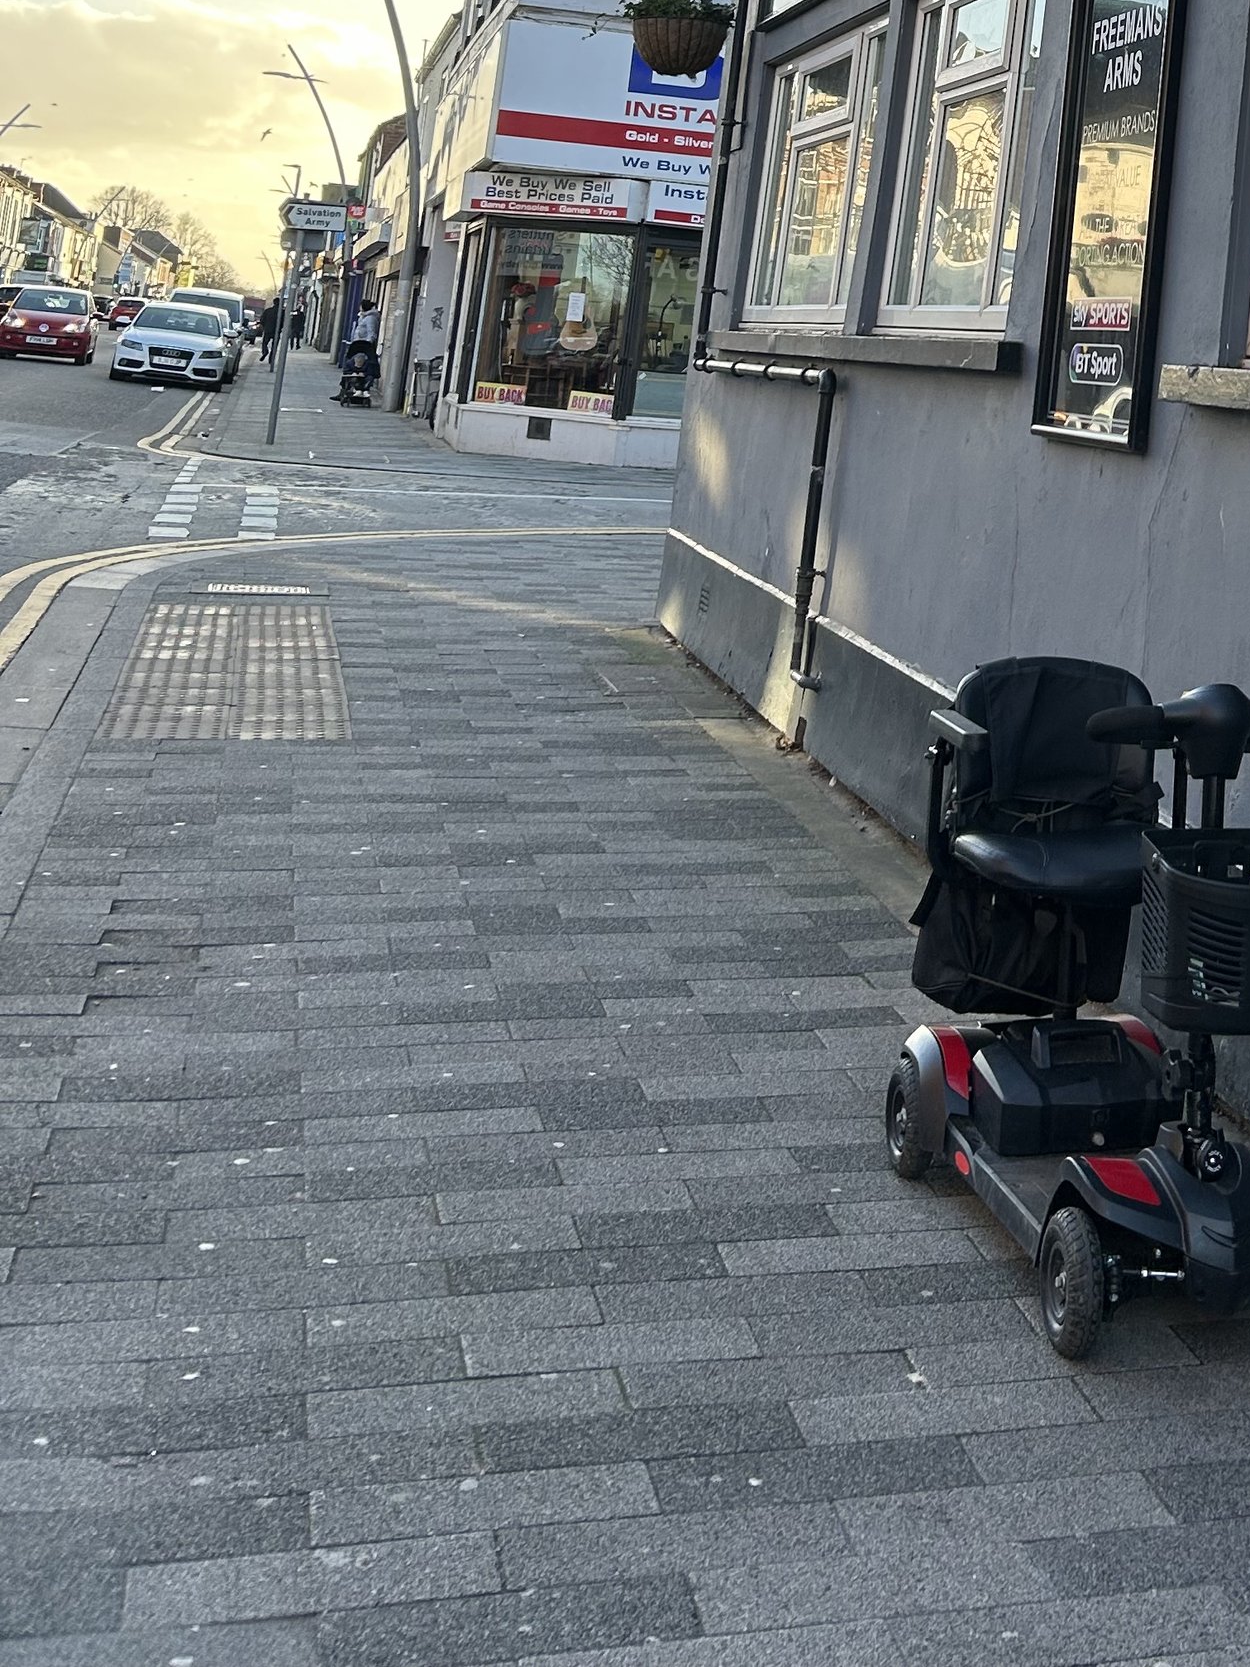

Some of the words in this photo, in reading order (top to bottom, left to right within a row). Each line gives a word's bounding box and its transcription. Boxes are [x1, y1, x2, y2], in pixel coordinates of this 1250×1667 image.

[1092, 1, 1166, 55] FREEMANS
[1103, 50, 1142, 93] ARMS
[625, 130, 659, 143] Gold
[1083, 119, 1121, 144] PREMIUM
[1121, 110, 1156, 137] BRANDS
[622, 156, 650, 169] We
[657, 160, 692, 175] Buy
[491, 174, 514, 187] We
[519, 177, 548, 191] Buy
[554, 178, 577, 191] We
[582, 180, 611, 193] Sell
[1115, 165, 1141, 188] VALUE
[485, 186, 521, 199] Best
[526, 189, 575, 202] Prices
[580, 192, 614, 205] Paid
[664, 184, 708, 201] Inst
[296, 207, 341, 218] Salvation
[480, 201, 506, 210] Game
[508, 202, 549, 213] Consoles
[559, 205, 591, 214] Games
[305, 218, 331, 227] Army
[1111, 242, 1144, 264] ACTION
[1073, 301, 1088, 327] sky
[1089, 302, 1129, 324] SPORTS
[1075, 353, 1091, 374] BT
[1090, 351, 1117, 379] Sport
[477, 386, 497, 400] BUY
[499, 388, 524, 403] BACK
[571, 396, 591, 409] BUY
